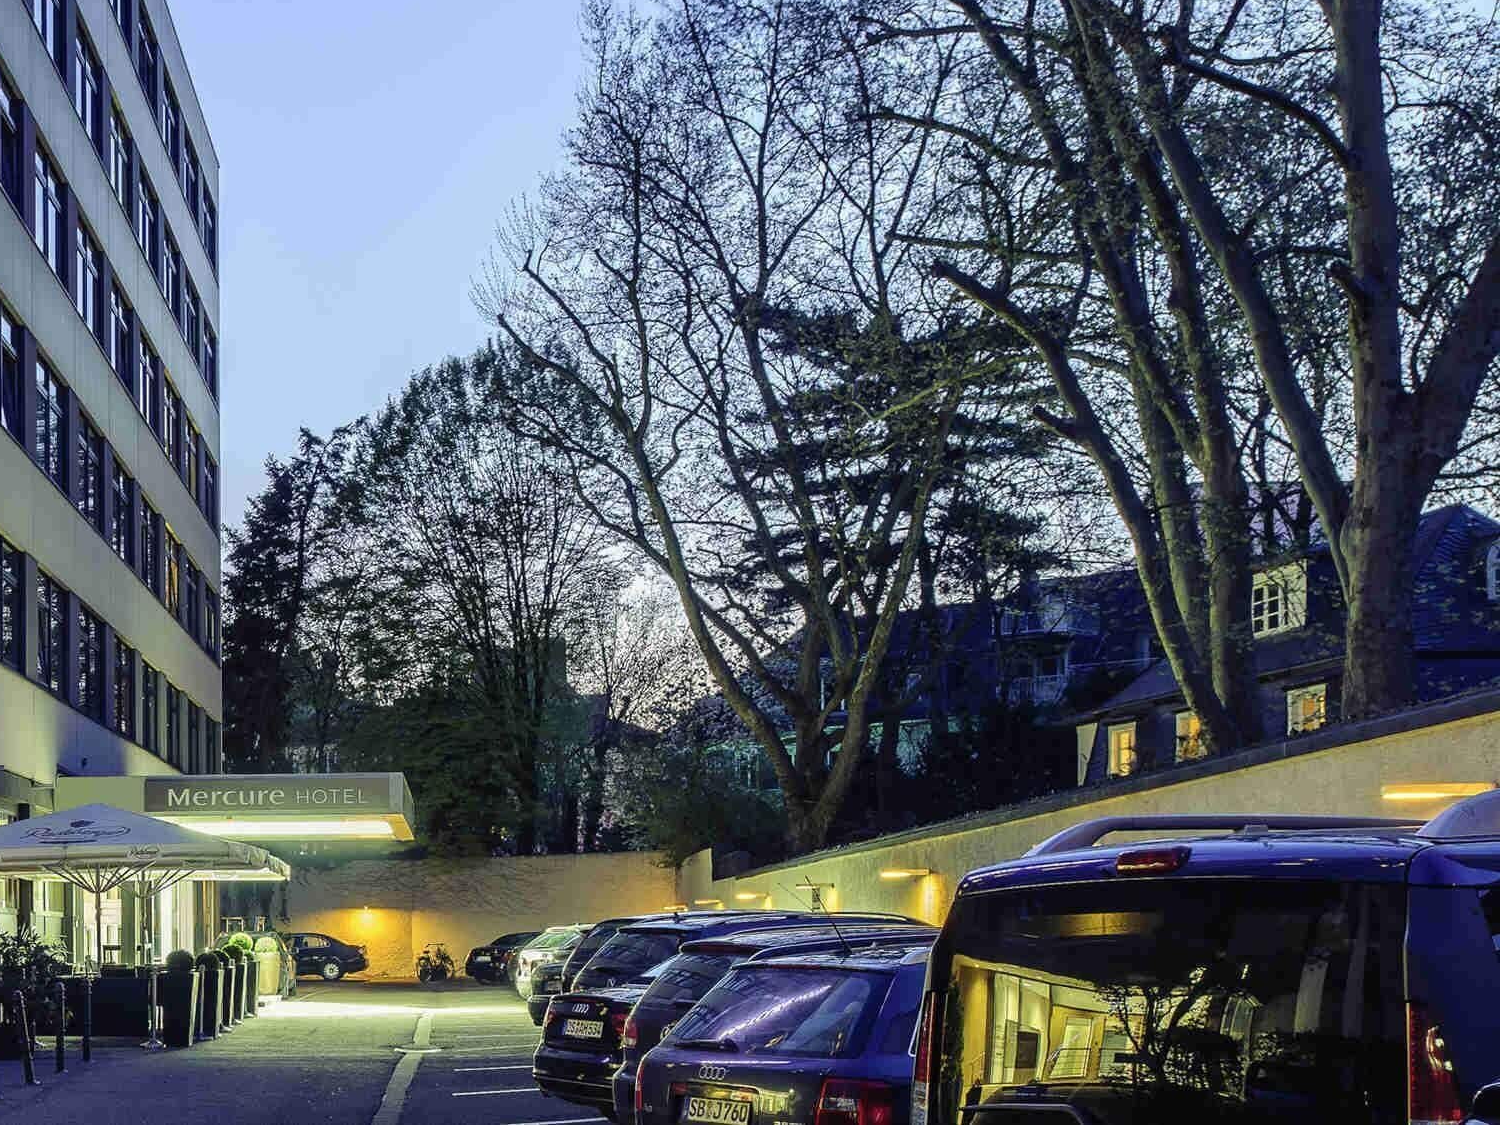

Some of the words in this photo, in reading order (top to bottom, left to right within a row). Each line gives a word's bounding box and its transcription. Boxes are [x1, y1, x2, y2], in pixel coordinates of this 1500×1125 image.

[167, 787, 286, 807] Mercure
[296, 787, 369, 805] HOTEL
[689, 1097, 706, 1118] SB
